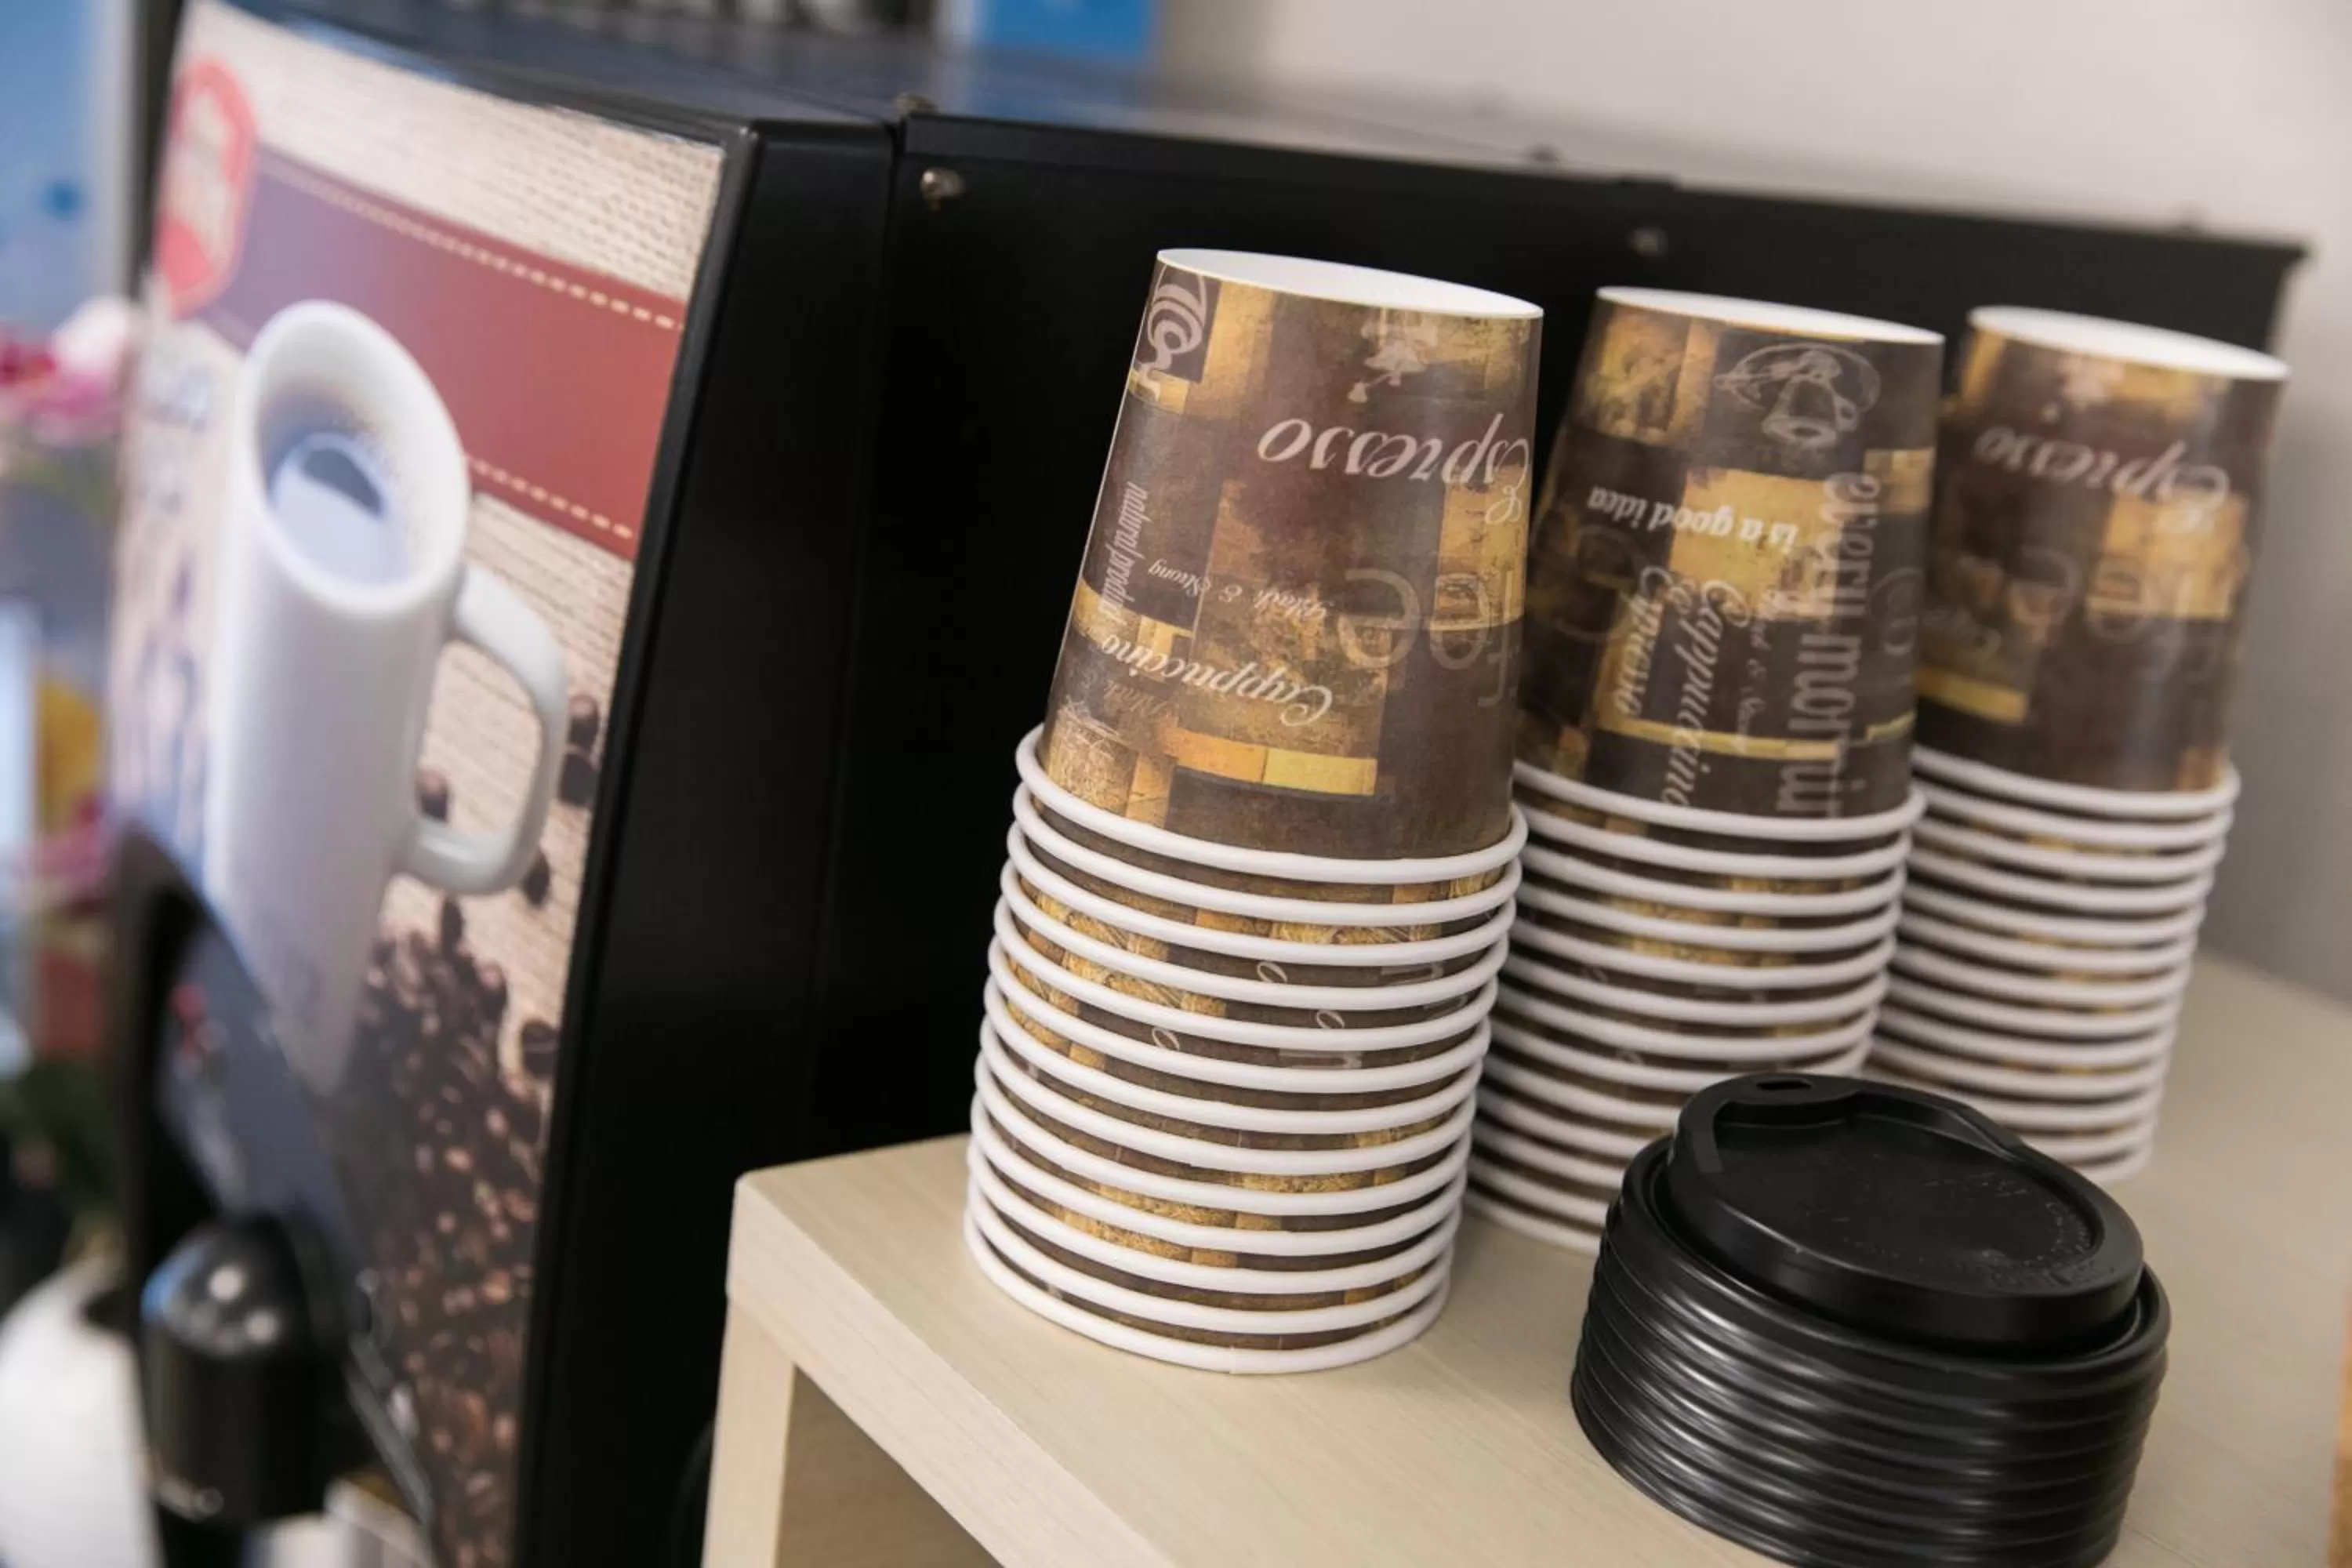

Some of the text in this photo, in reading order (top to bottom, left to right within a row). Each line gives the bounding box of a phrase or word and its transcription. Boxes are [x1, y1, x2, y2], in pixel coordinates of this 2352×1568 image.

[1257, 412, 1530, 525] Espresso
[1973, 426, 2230, 535] Espresso
[1099, 481, 1152, 626] natural product
[1587, 485, 1800, 554] is a good idea
[1147, 557, 1212, 597] Strong
[1218, 583, 1243, 604] &
[1100, 633, 1333, 726] Cappuccino
[1613, 565, 1698, 717] Espresso
